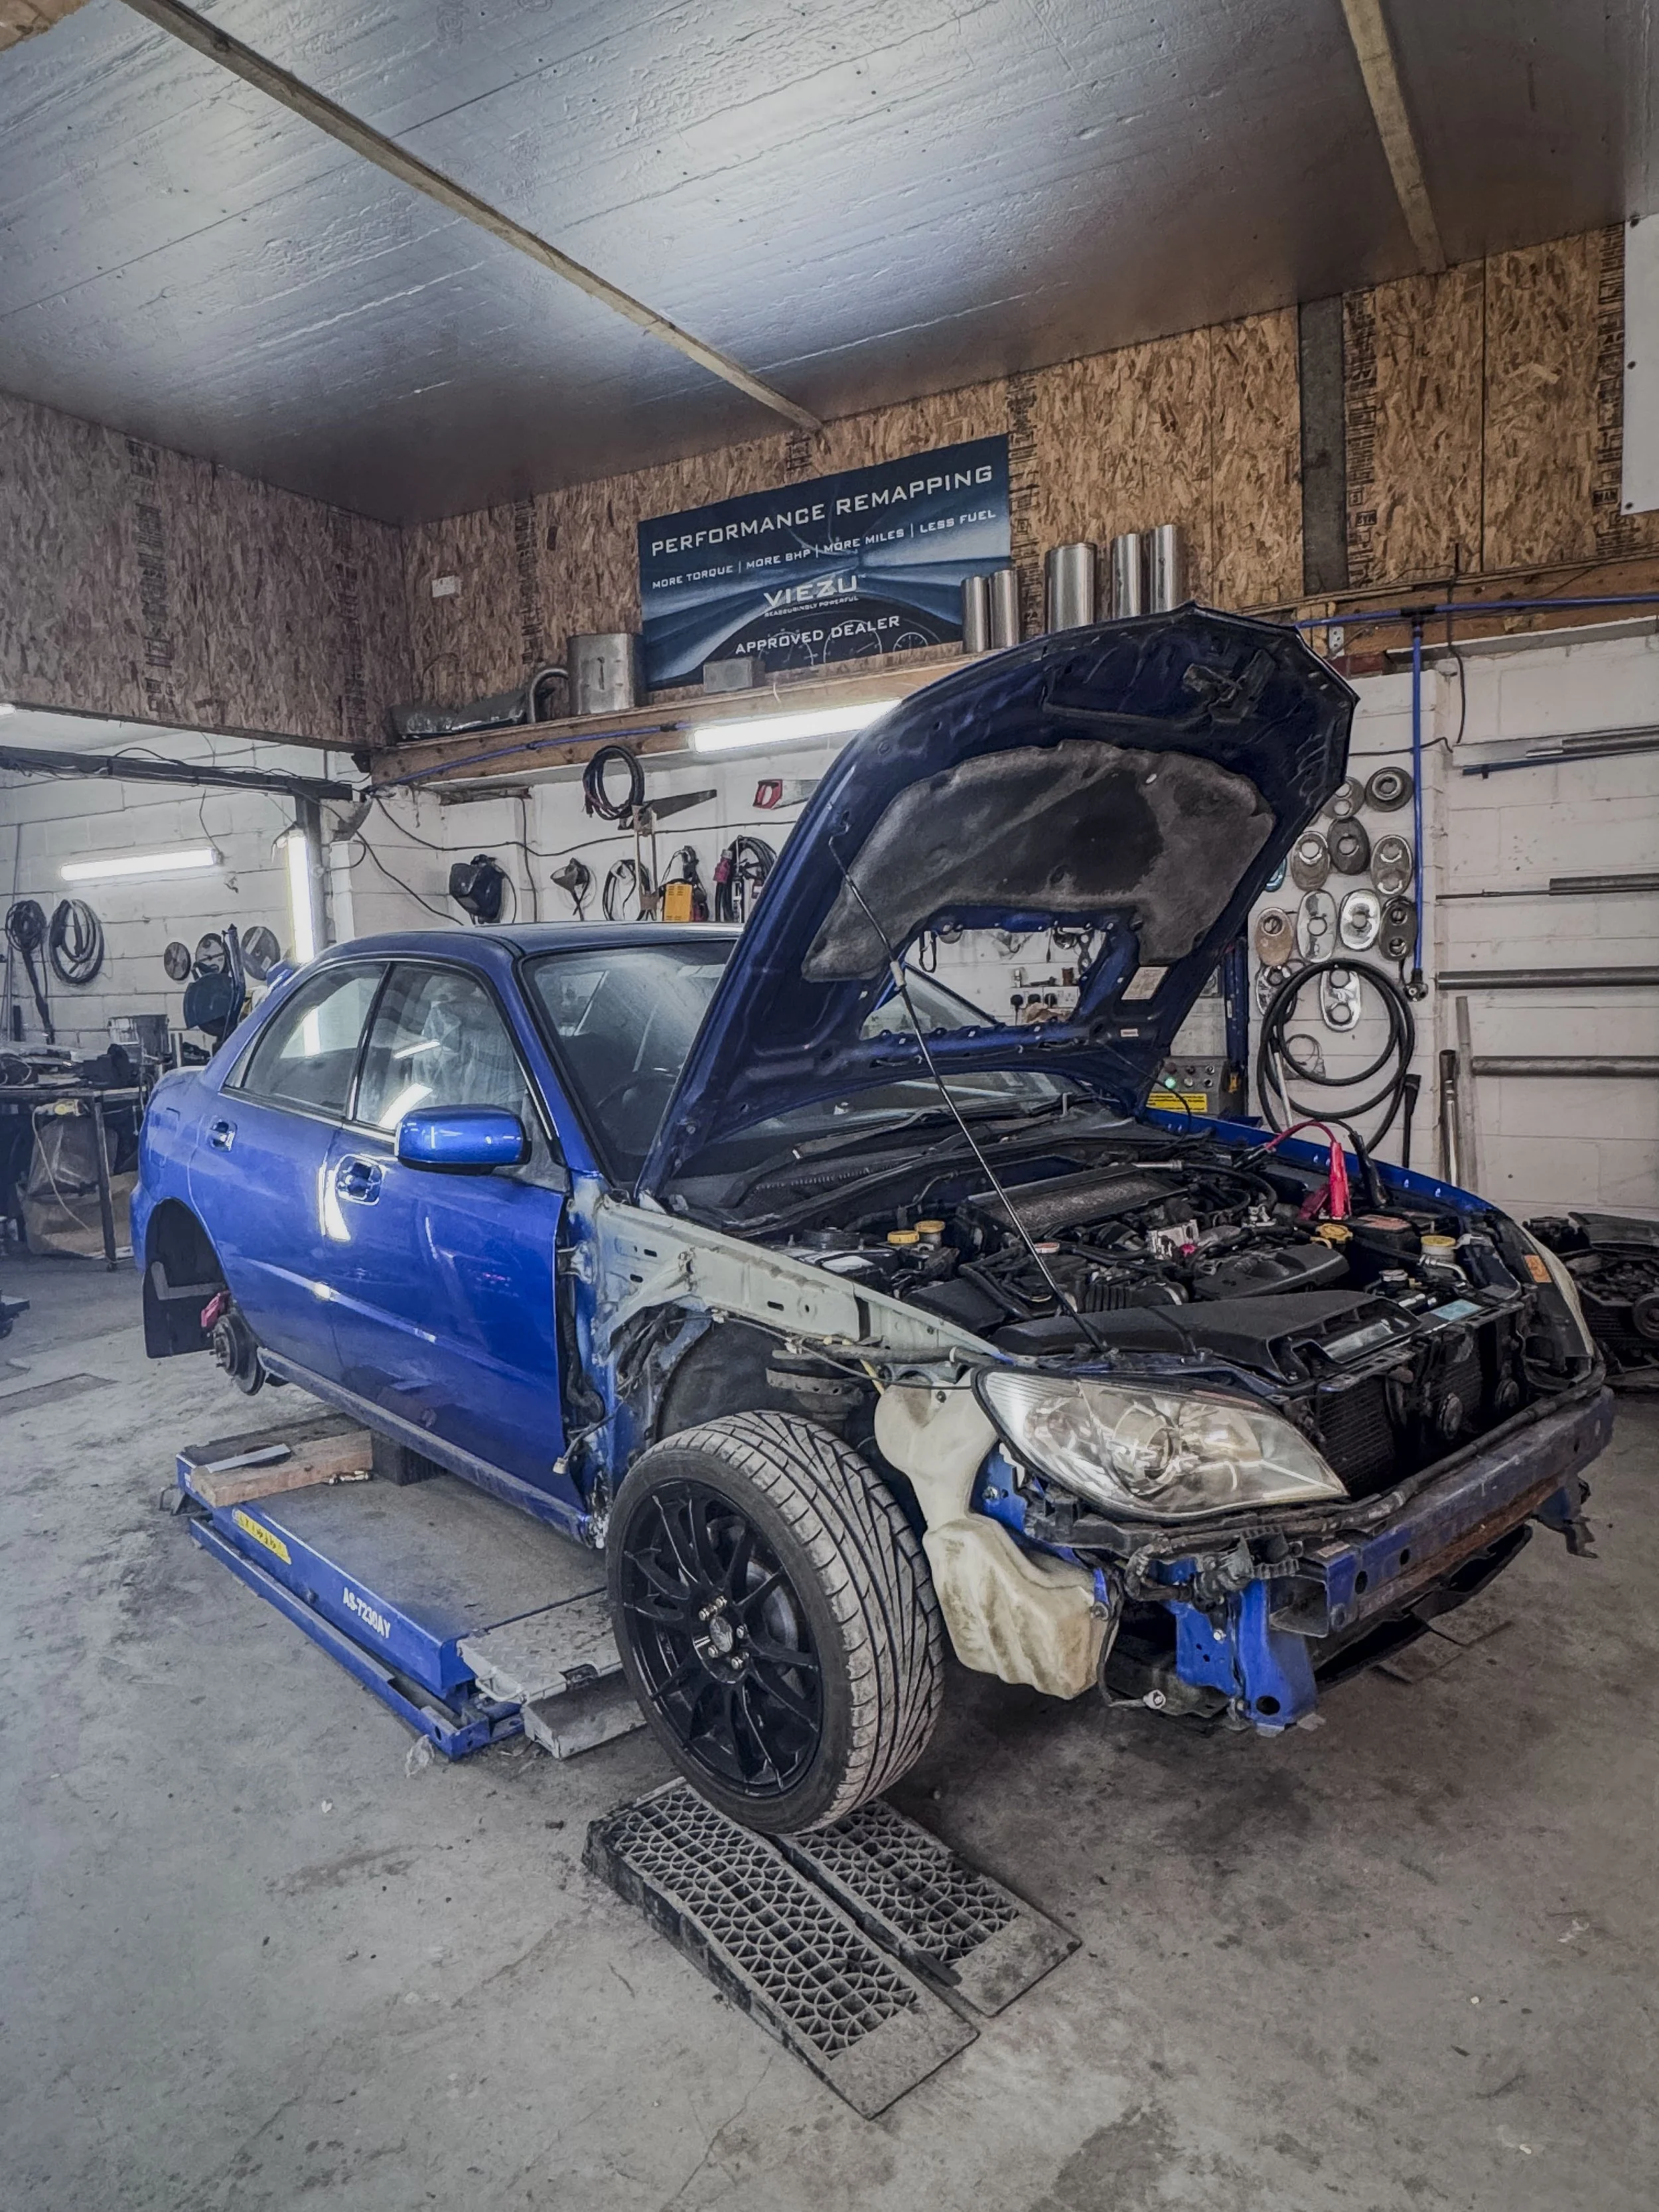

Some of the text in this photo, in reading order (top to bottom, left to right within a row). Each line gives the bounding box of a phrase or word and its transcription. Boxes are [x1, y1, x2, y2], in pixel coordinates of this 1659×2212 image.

[652, 465, 992, 556] PERFORMANCE REMAPPING
[652, 509, 996, 589] MORE TORQUE MORE BHP MORE MILES LESS FUEL
[763, 575, 857, 609] VIEZU
[735, 615, 900, 655] APPROVED DEALER
